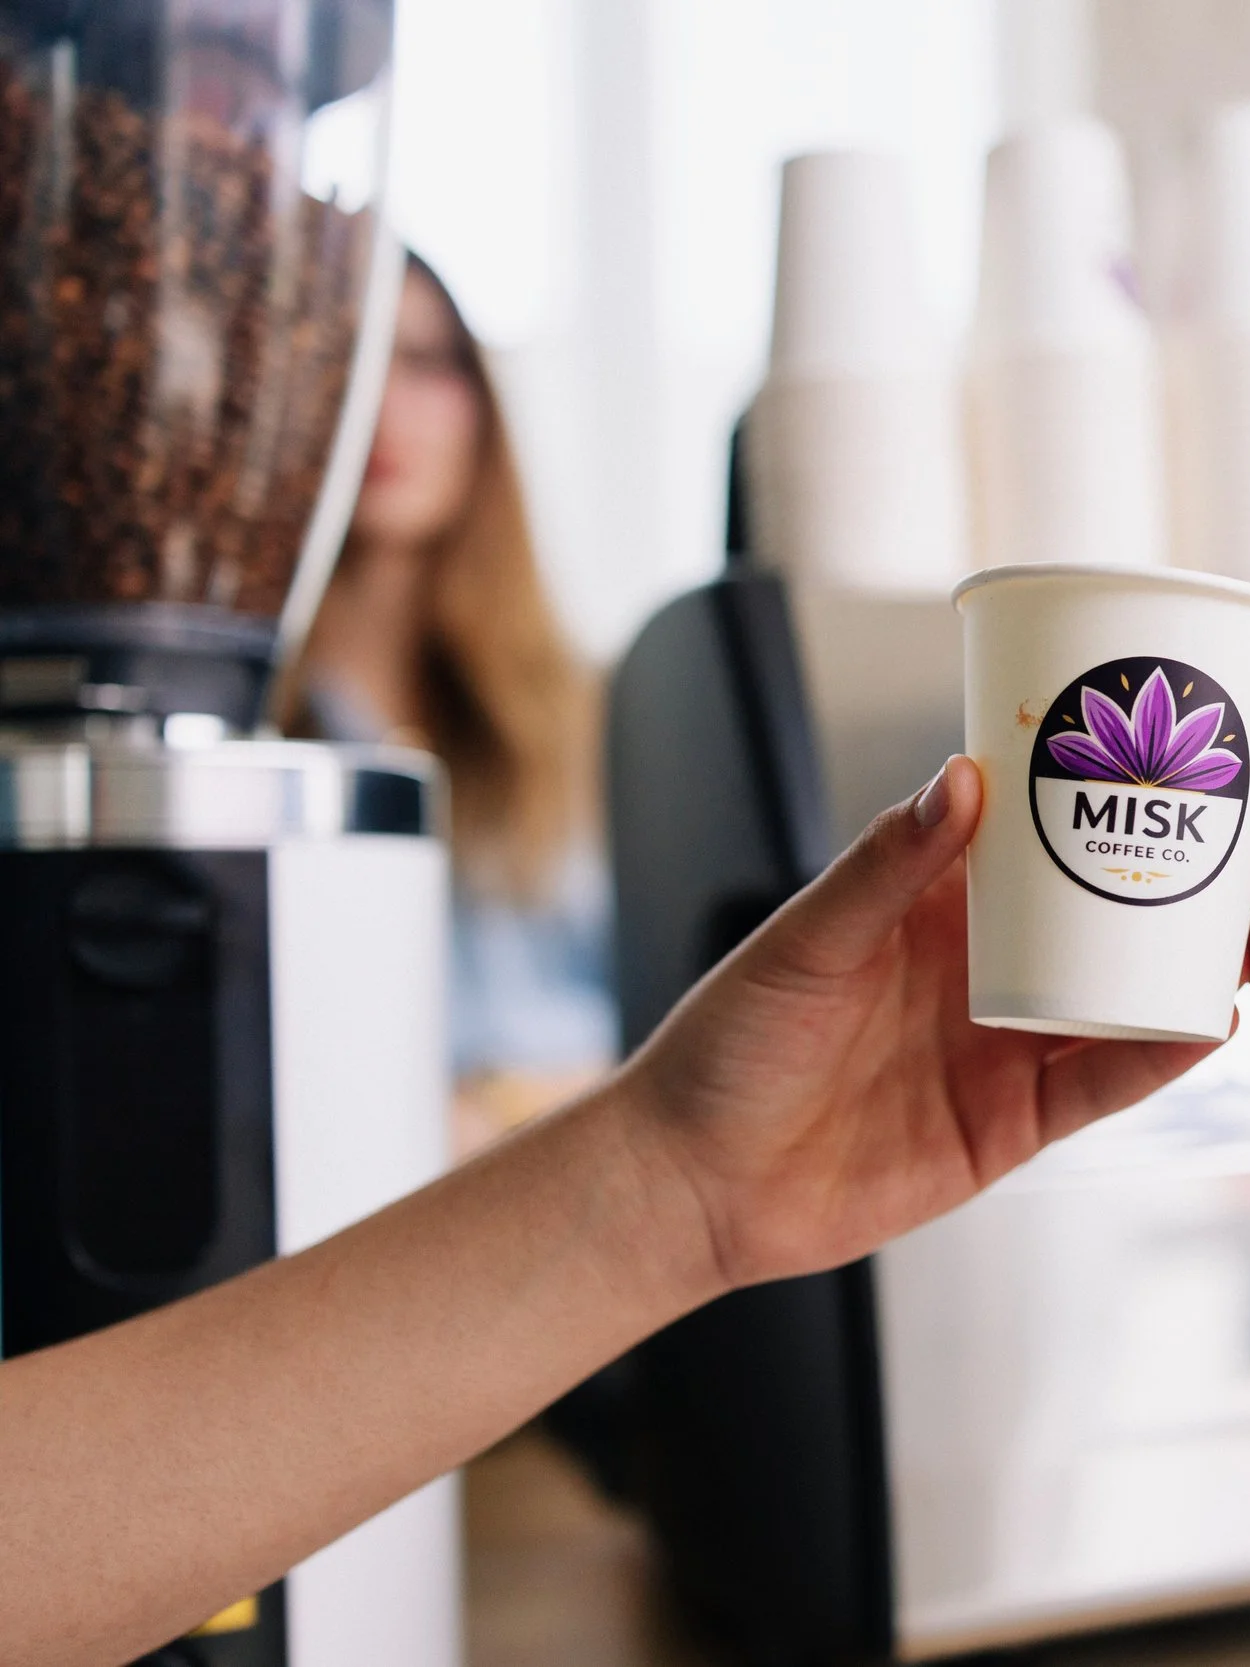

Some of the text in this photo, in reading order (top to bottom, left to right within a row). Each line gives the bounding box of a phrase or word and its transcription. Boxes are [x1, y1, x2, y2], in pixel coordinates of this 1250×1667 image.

[1072, 791, 1208, 843] MISK
[1085, 840, 1190, 863] COFFEE CO.
